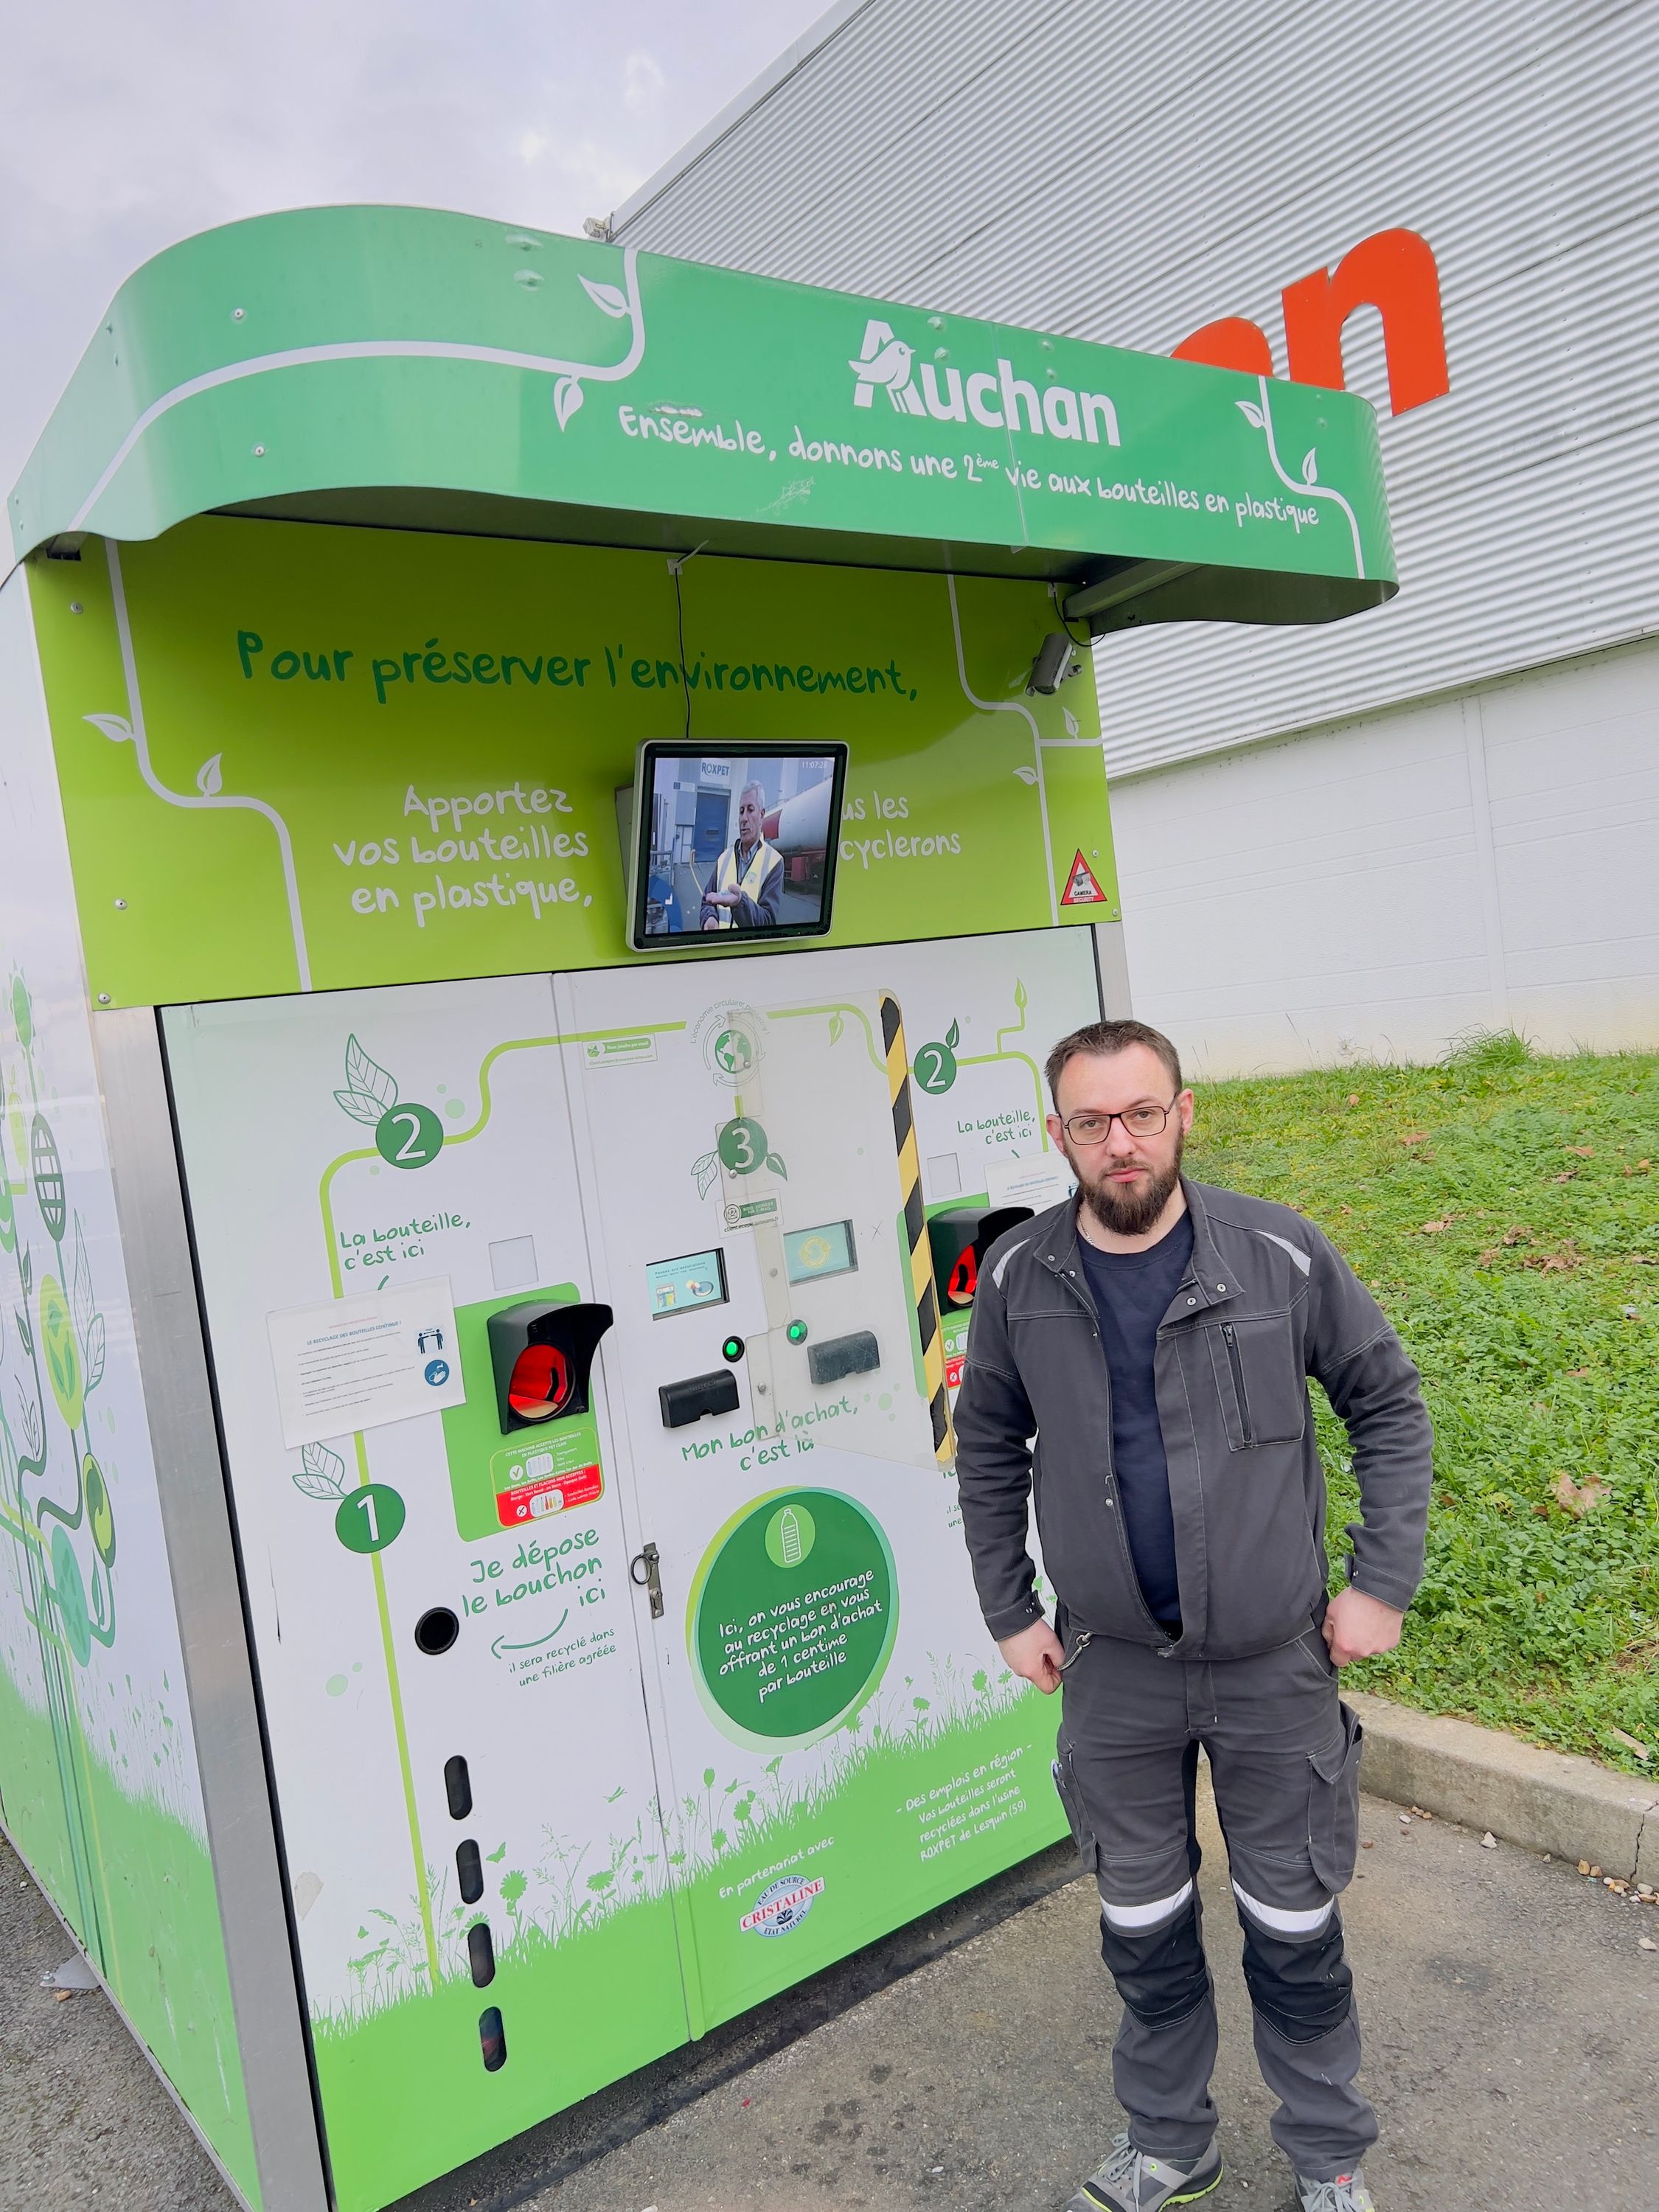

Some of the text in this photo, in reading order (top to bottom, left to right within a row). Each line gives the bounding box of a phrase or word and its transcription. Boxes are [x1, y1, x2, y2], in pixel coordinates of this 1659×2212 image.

[848, 319, 1121, 446] Auchan
[619, 404, 1320, 535] Ensemble, donnons une 2ème vie aux bouteilles en plastique
[237, 630, 917, 704] Pour préserver l'environnement,
[701, 762, 730, 776] ROXPET
[403, 782, 573, 833] Apportez
[873, 790, 909, 820] les
[333, 825, 589, 866] vos bouteilles
[352, 874, 593, 928] en plastique,
[924, 1049, 946, 1088] 2
[391, 1112, 427, 1161] 2
[958, 1110, 1036, 1133] La bouteille,
[985, 1125, 1032, 1144] c'est ici
[731, 1127, 754, 1169] 3
[340, 1212, 471, 1248] La bouteille,
[344, 1239, 424, 1270] c'est ici
[313, 1333, 338, 1345] RECYCLAGE
[349, 1326, 375, 1337] BOUTEILLES
[376, 1321, 398, 1331] CONTINUE
[681, 1395, 858, 1461] Mon bon d'achat,
[740, 1430, 814, 1471] c'est là
[356, 1493, 380, 1543] 1
[948, 1518, 962, 1528] une
[470, 1528, 599, 1583] Je dépose
[462, 1557, 602, 1617] le bouchon
[577, 1578, 605, 1607] ici
[719, 1569, 874, 1638] Ici, on vous encourage
[719, 1599, 883, 1675] offrant un bon d'achat
[725, 1588, 870, 1655] au recyclage en vous
[508, 1628, 614, 1673] il sera recyclé dans
[519, 1644, 616, 1686] une filière agréée
[759, 1633, 848, 1677] de 1 centime
[759, 1651, 847, 1703] par bouteille
[905, 1794, 926, 1811] Des
[929, 1772, 970, 1799] emplois
[973, 1764, 987, 1778] en
[990, 1747, 1023, 1770] région
[938, 1785, 984, 1815] bouteilles
[987, 1768, 1017, 1791] seront
[919, 1785, 1020, 1843] recyclées dans l'usine
[919, 1798, 1027, 1862] ROXPET de Lesquin (59)
[719, 1837, 835, 1899] En partenariat avec
[757, 1877, 805, 1905] EAU DE SOURCE
[742, 1880, 822, 1928] CRISTALINE
[764, 1909, 807, 1935] ETAT NATUREL
